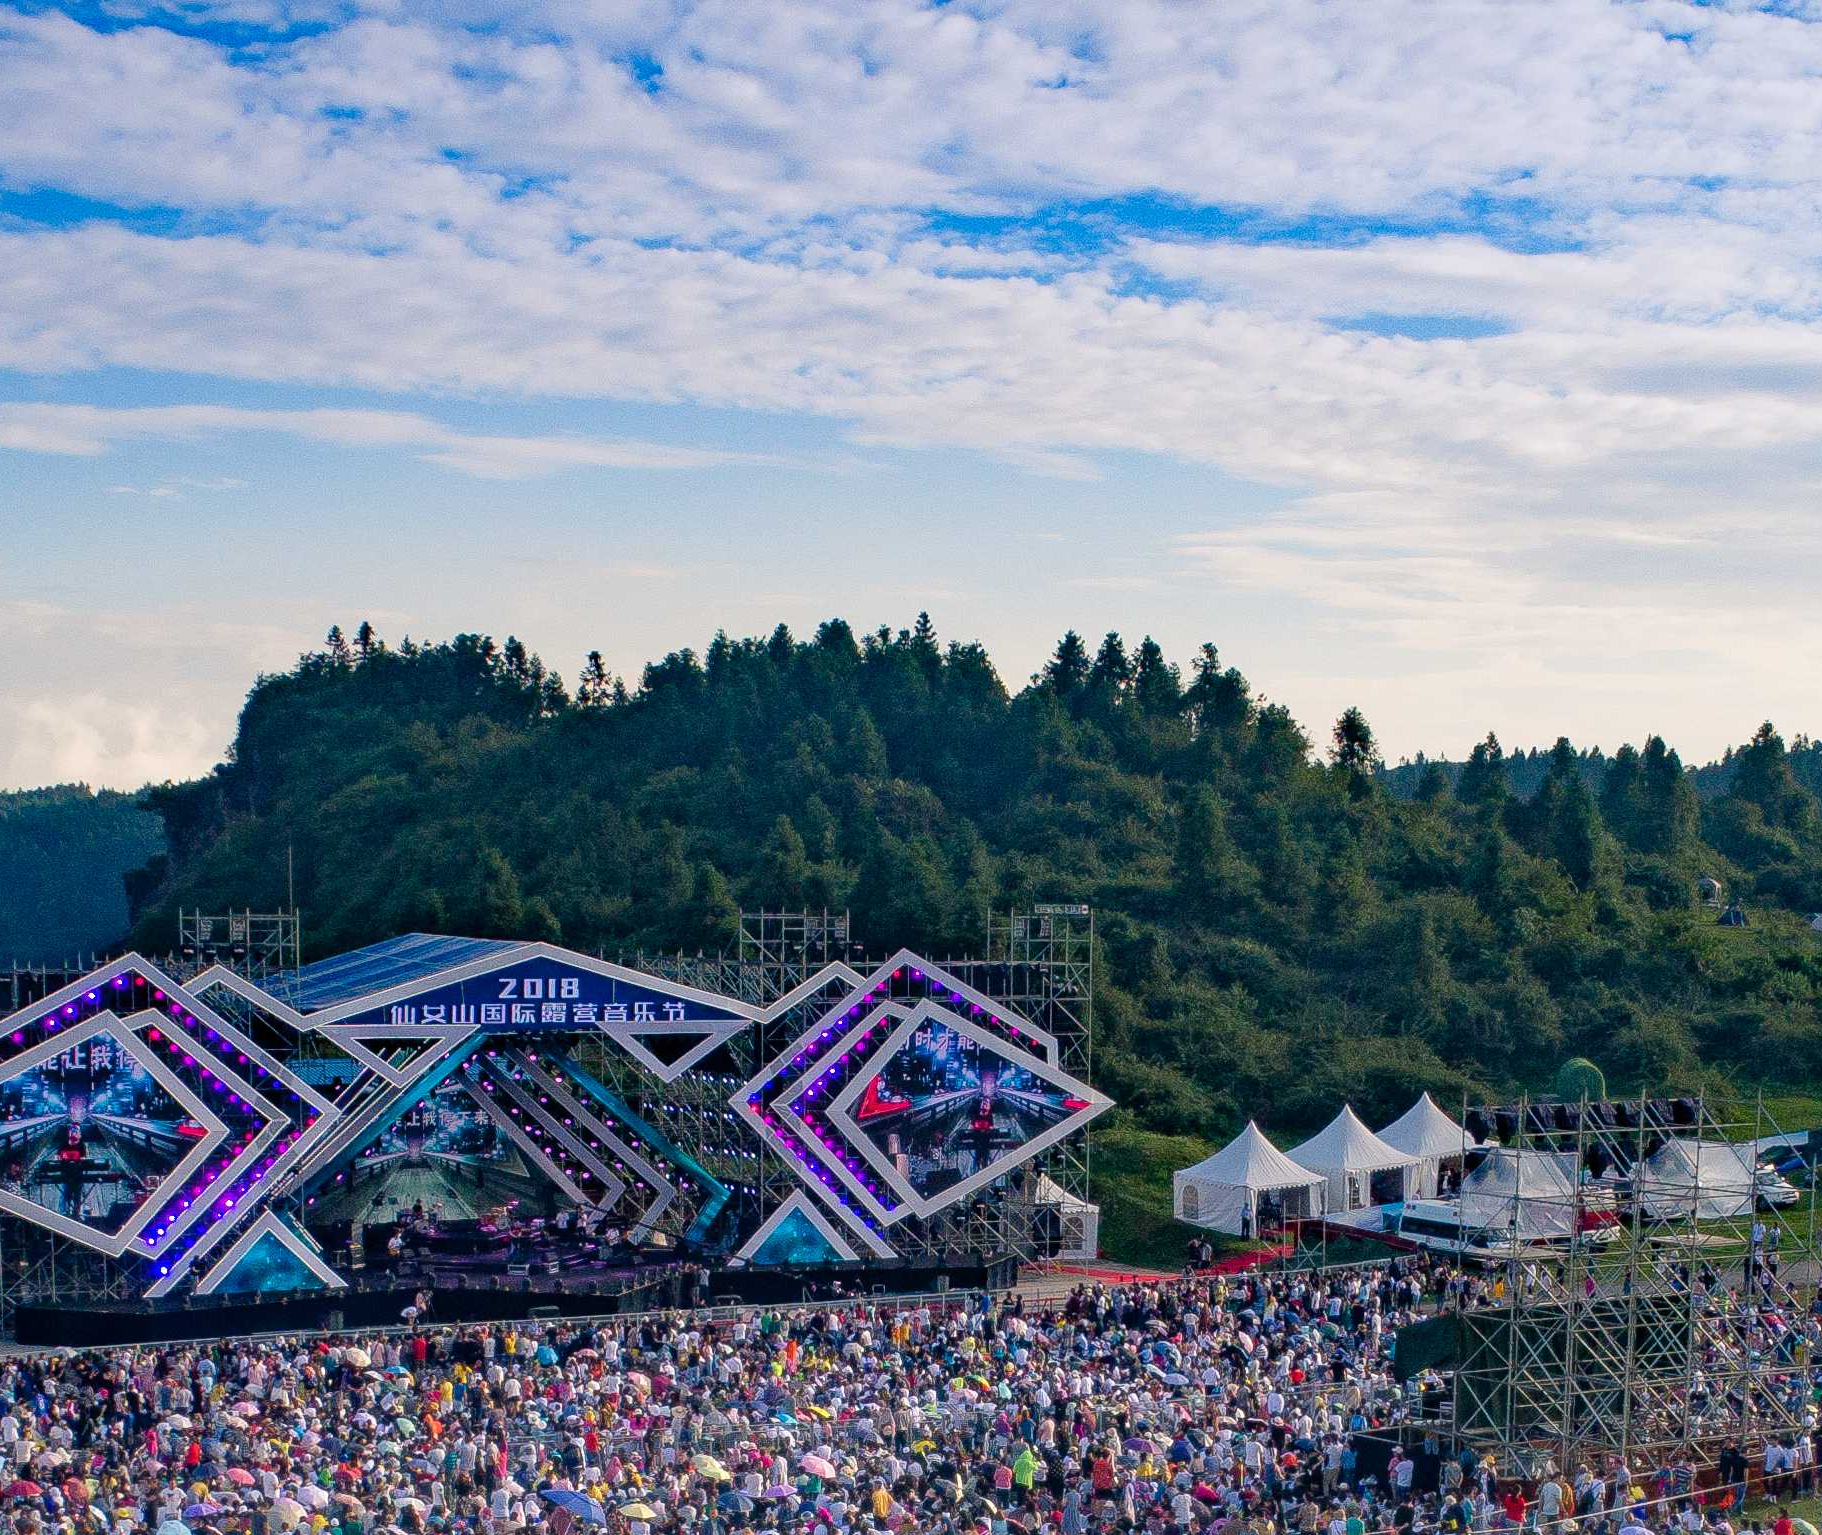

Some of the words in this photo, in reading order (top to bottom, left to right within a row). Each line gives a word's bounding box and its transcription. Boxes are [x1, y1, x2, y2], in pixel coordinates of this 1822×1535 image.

[499, 978, 579, 999] 2018
[391, 1002, 686, 1024] 仙女山国际露营音乐节
